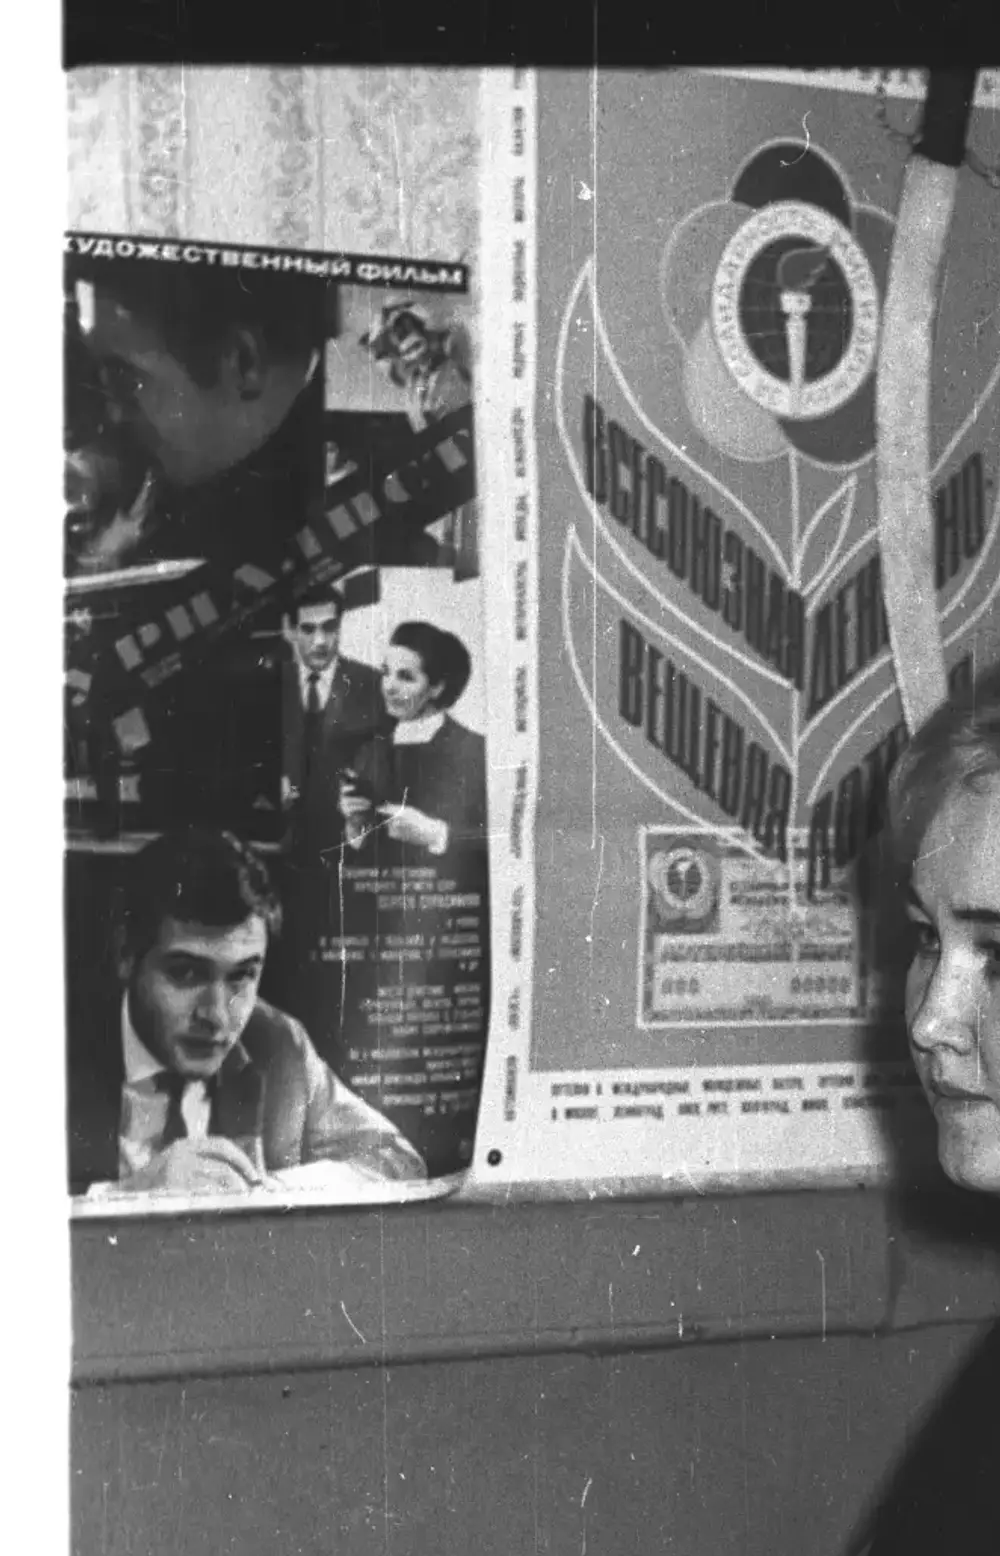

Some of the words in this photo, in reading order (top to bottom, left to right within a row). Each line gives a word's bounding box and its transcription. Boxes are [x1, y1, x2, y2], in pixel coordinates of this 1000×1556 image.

[357, 262, 462, 285] ФИЛЬМ
[582, 392, 804, 690] ВСЕСОЮЗНАЯ
[618, 616, 793, 863] ВЕЩЕВАЯ
